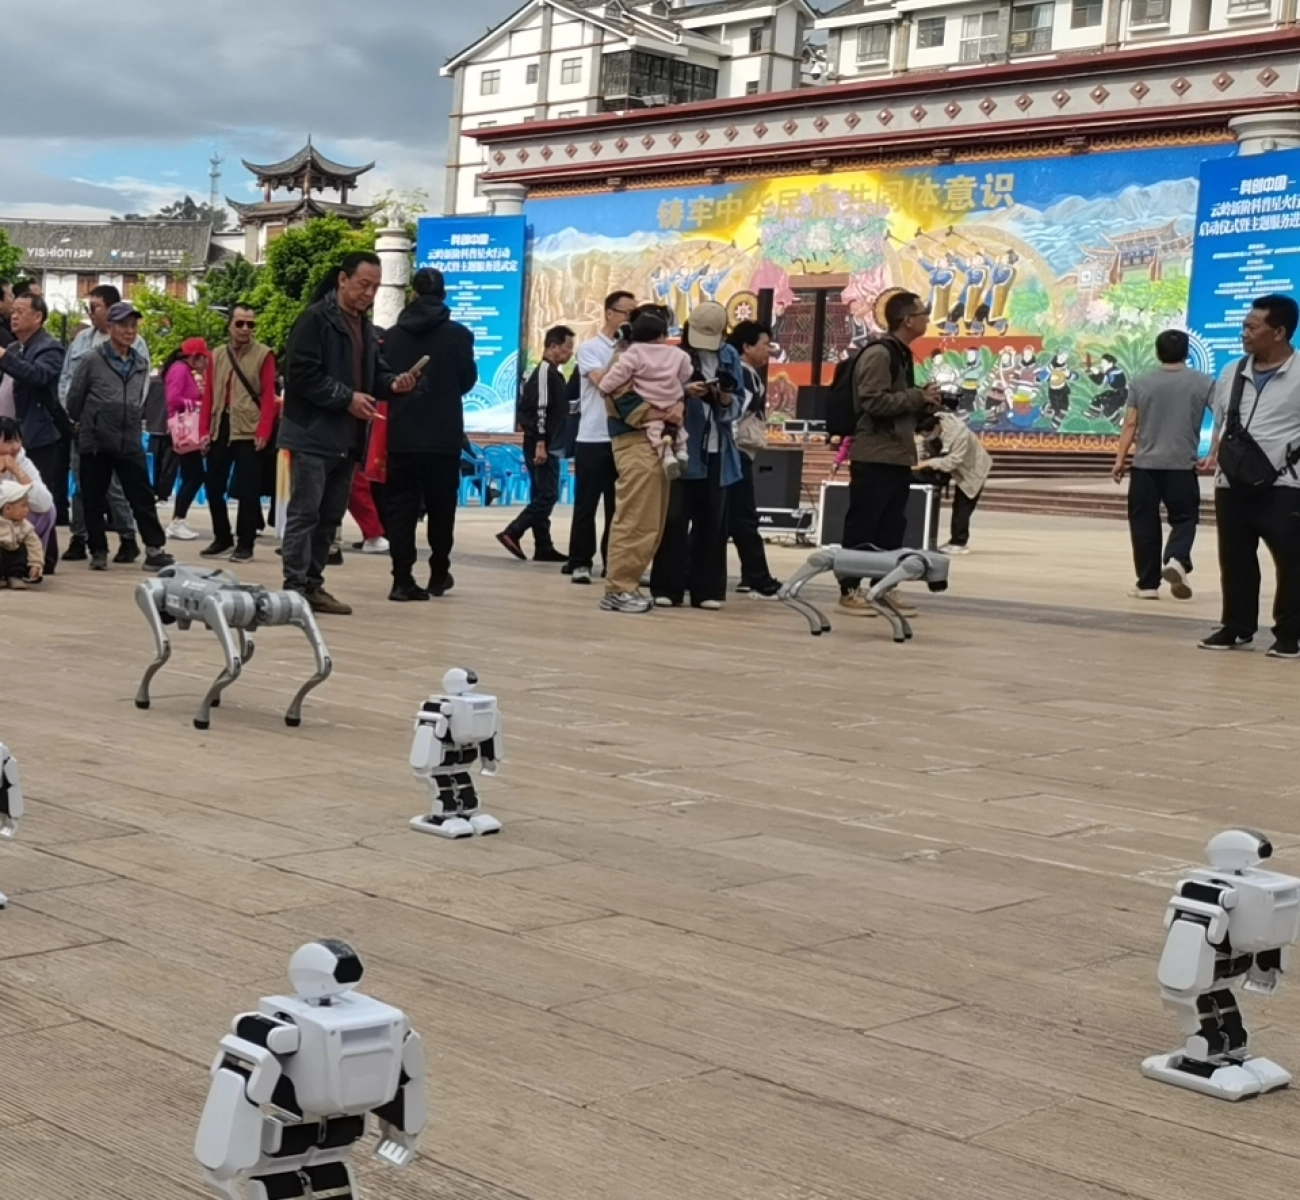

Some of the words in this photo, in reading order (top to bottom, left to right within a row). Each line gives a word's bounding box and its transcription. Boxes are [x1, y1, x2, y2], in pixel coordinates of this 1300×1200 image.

[657, 173, 1015, 229] 铸牢中华民族共同体意识
